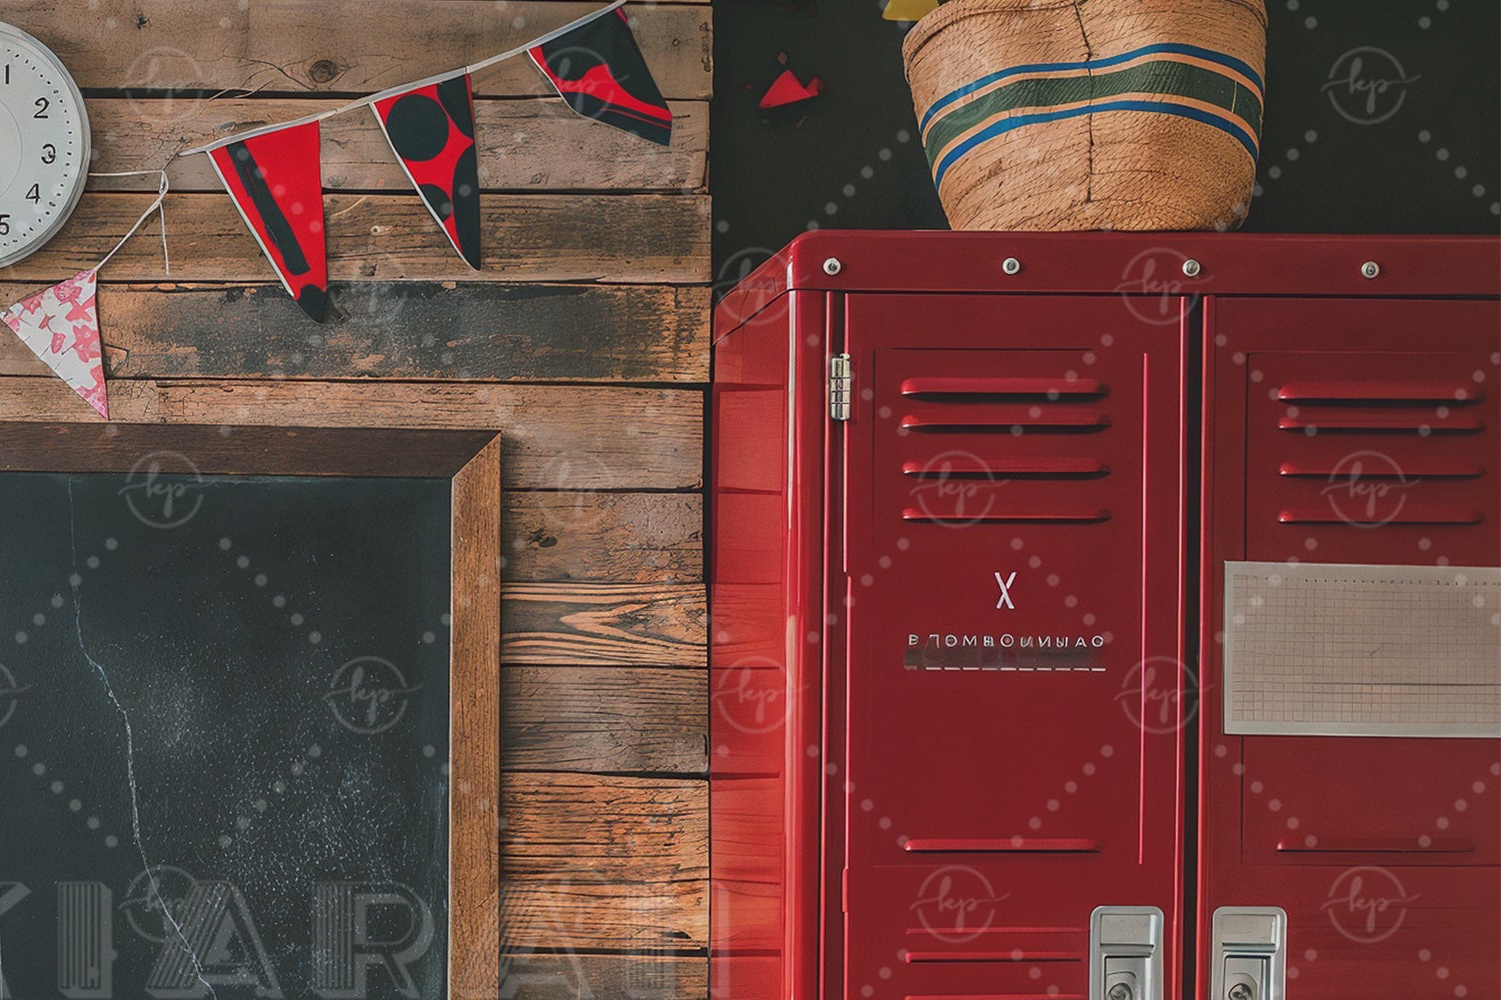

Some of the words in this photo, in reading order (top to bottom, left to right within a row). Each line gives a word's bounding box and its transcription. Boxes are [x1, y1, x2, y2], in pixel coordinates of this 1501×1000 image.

[4, 64, 10, 85] 1
[33, 97, 50, 119] 2
[41, 143, 56, 164] 3
[25, 183, 41, 205] 4
[994, 571, 1017, 610] X
